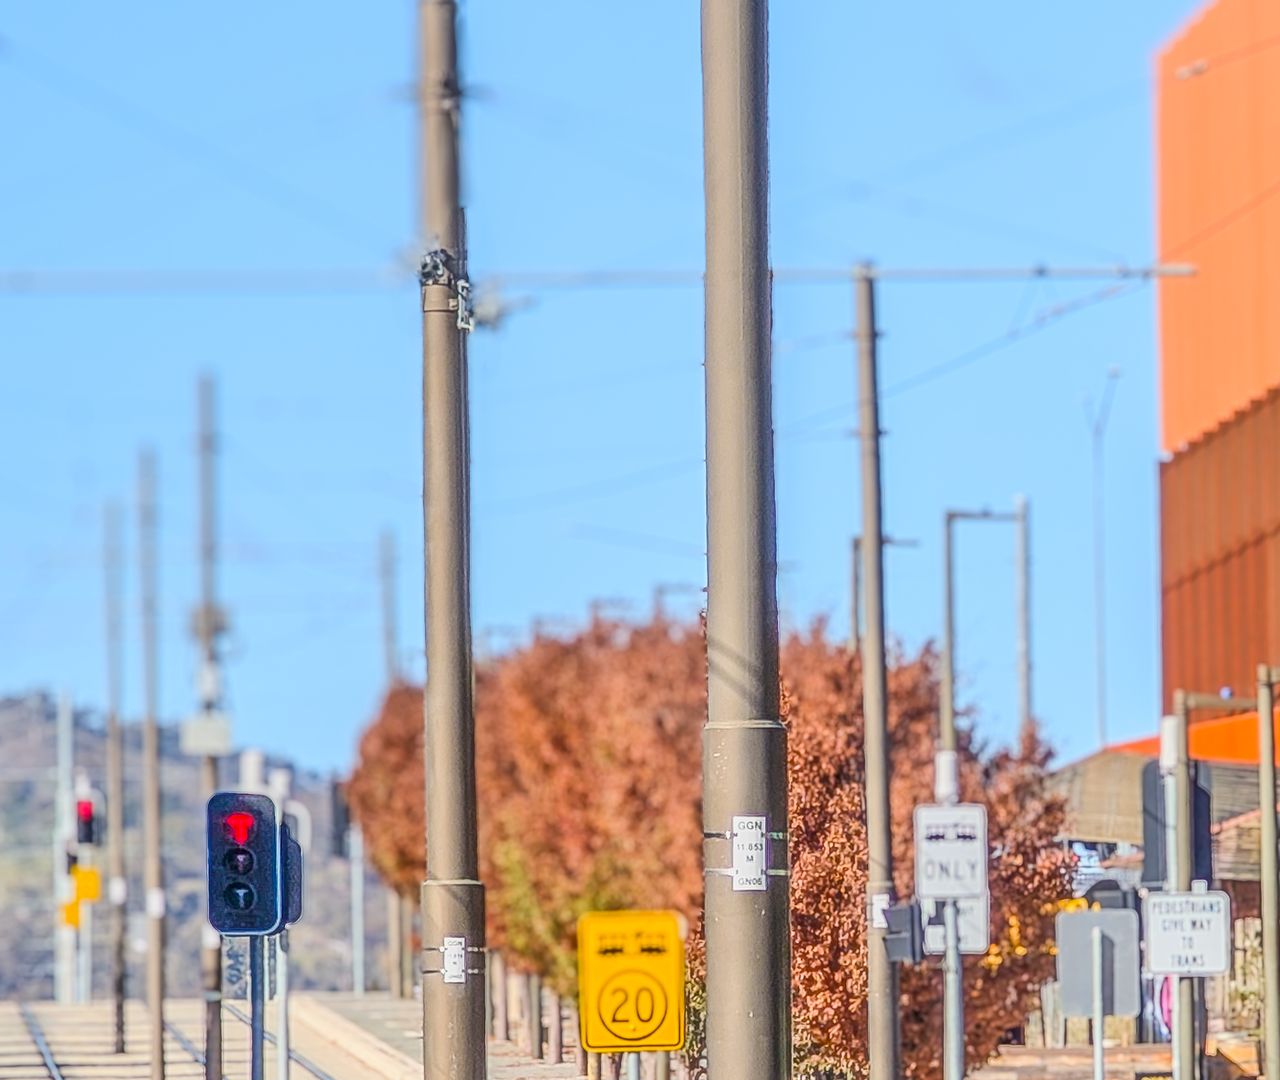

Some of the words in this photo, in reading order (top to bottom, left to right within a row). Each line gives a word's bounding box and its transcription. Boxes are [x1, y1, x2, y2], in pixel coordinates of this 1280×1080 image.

[738, 821, 762, 831] GGN
[924, 859, 978, 881] ONLY
[1152, 901, 1221, 914] PEDESTRIANS
[1161, 918, 1185, 932] GIVE
[1191, 918, 1212, 931] WAY
[1182, 935, 1194, 949] TO
[1171, 954, 1205, 968] TRAMS
[611, 987, 654, 1023] 20
